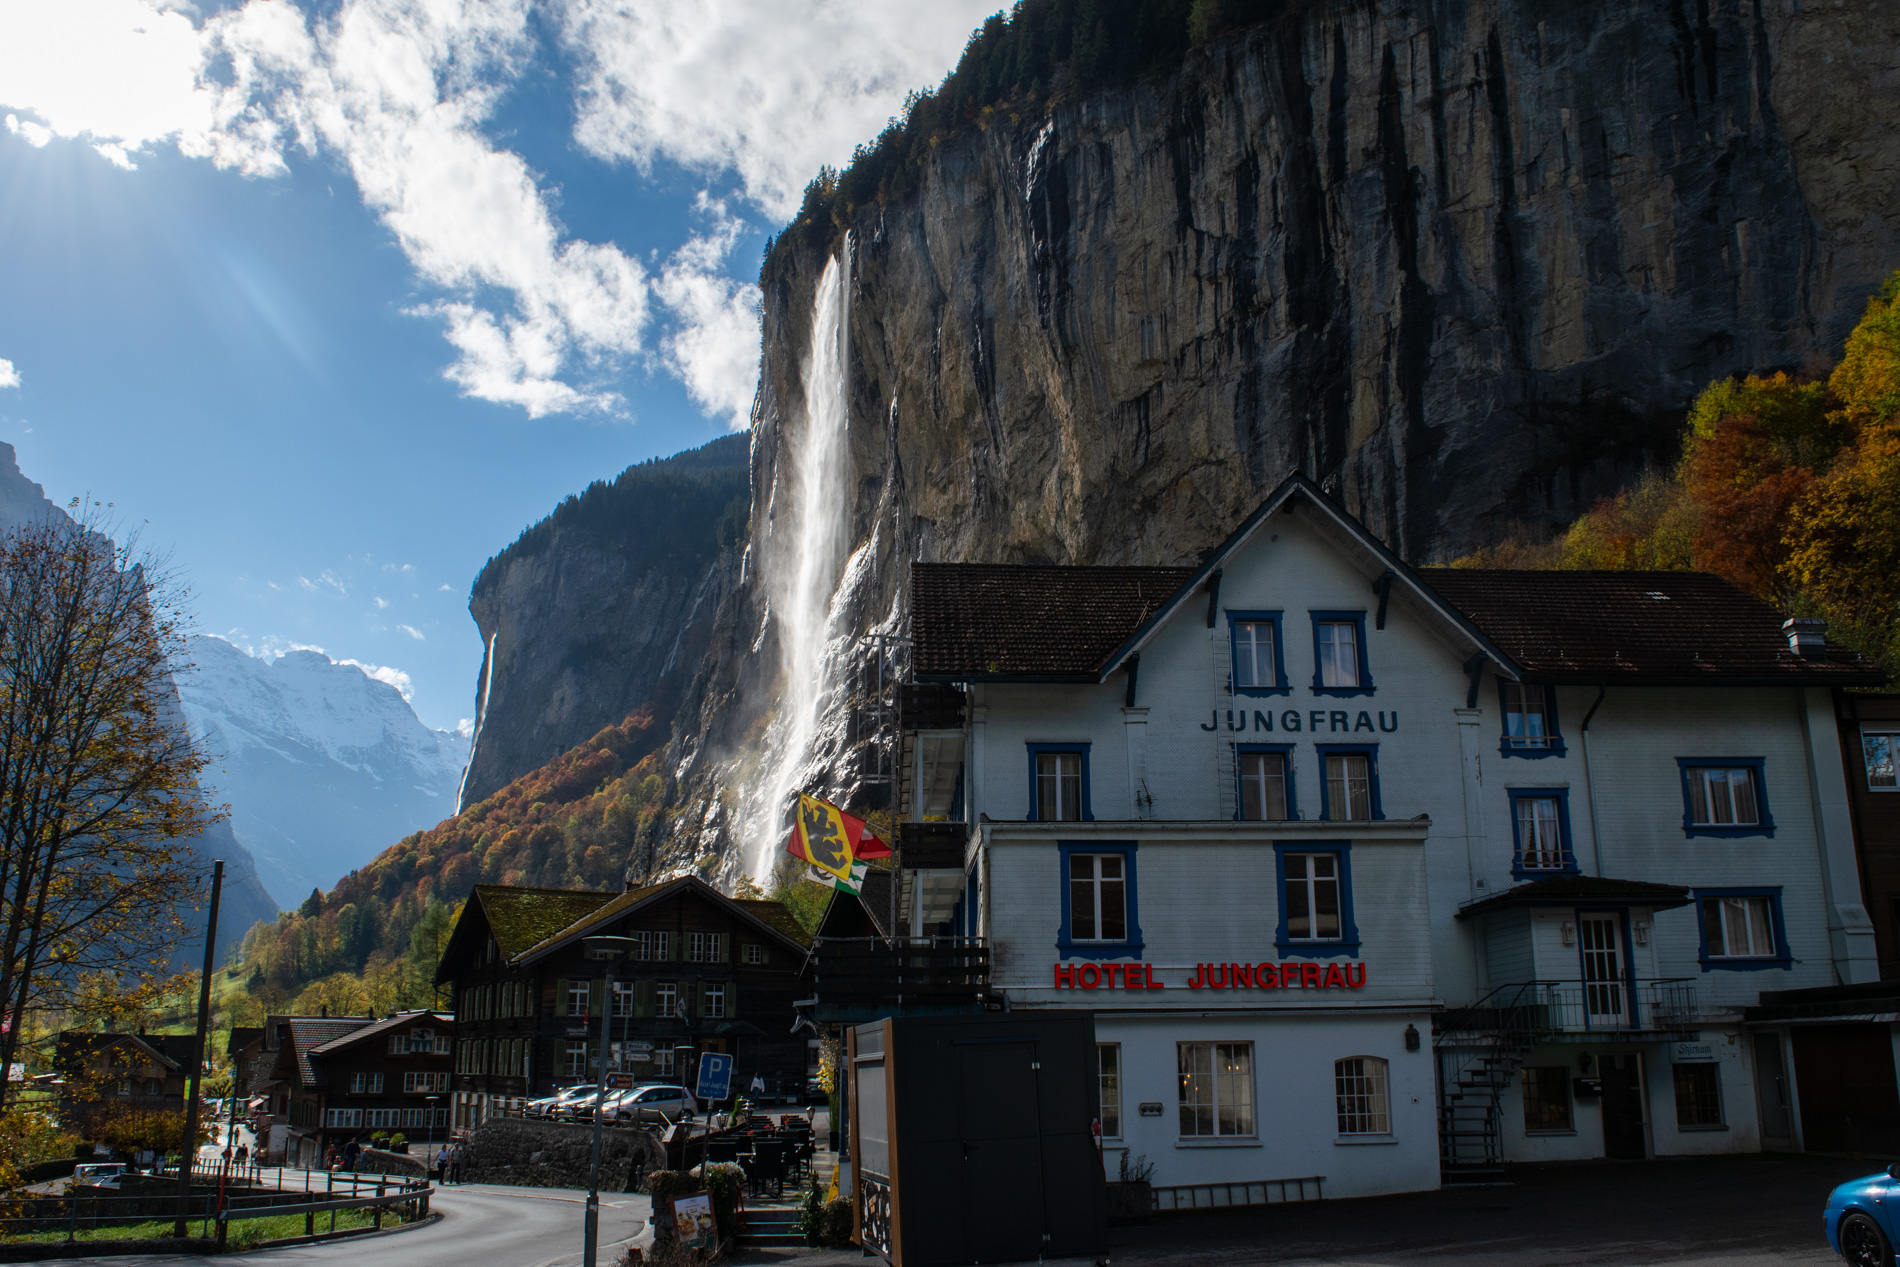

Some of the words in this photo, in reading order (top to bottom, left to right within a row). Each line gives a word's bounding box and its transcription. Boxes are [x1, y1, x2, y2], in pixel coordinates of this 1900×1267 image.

[1200, 709, 1399, 732] JUNGFRAU
[1054, 963, 1164, 989] HOTEL
[1188, 962, 1367, 989] JUNGFRAU
[1678, 1043, 1712, 1056] Skiraum
[709, 1058, 723, 1079] P
